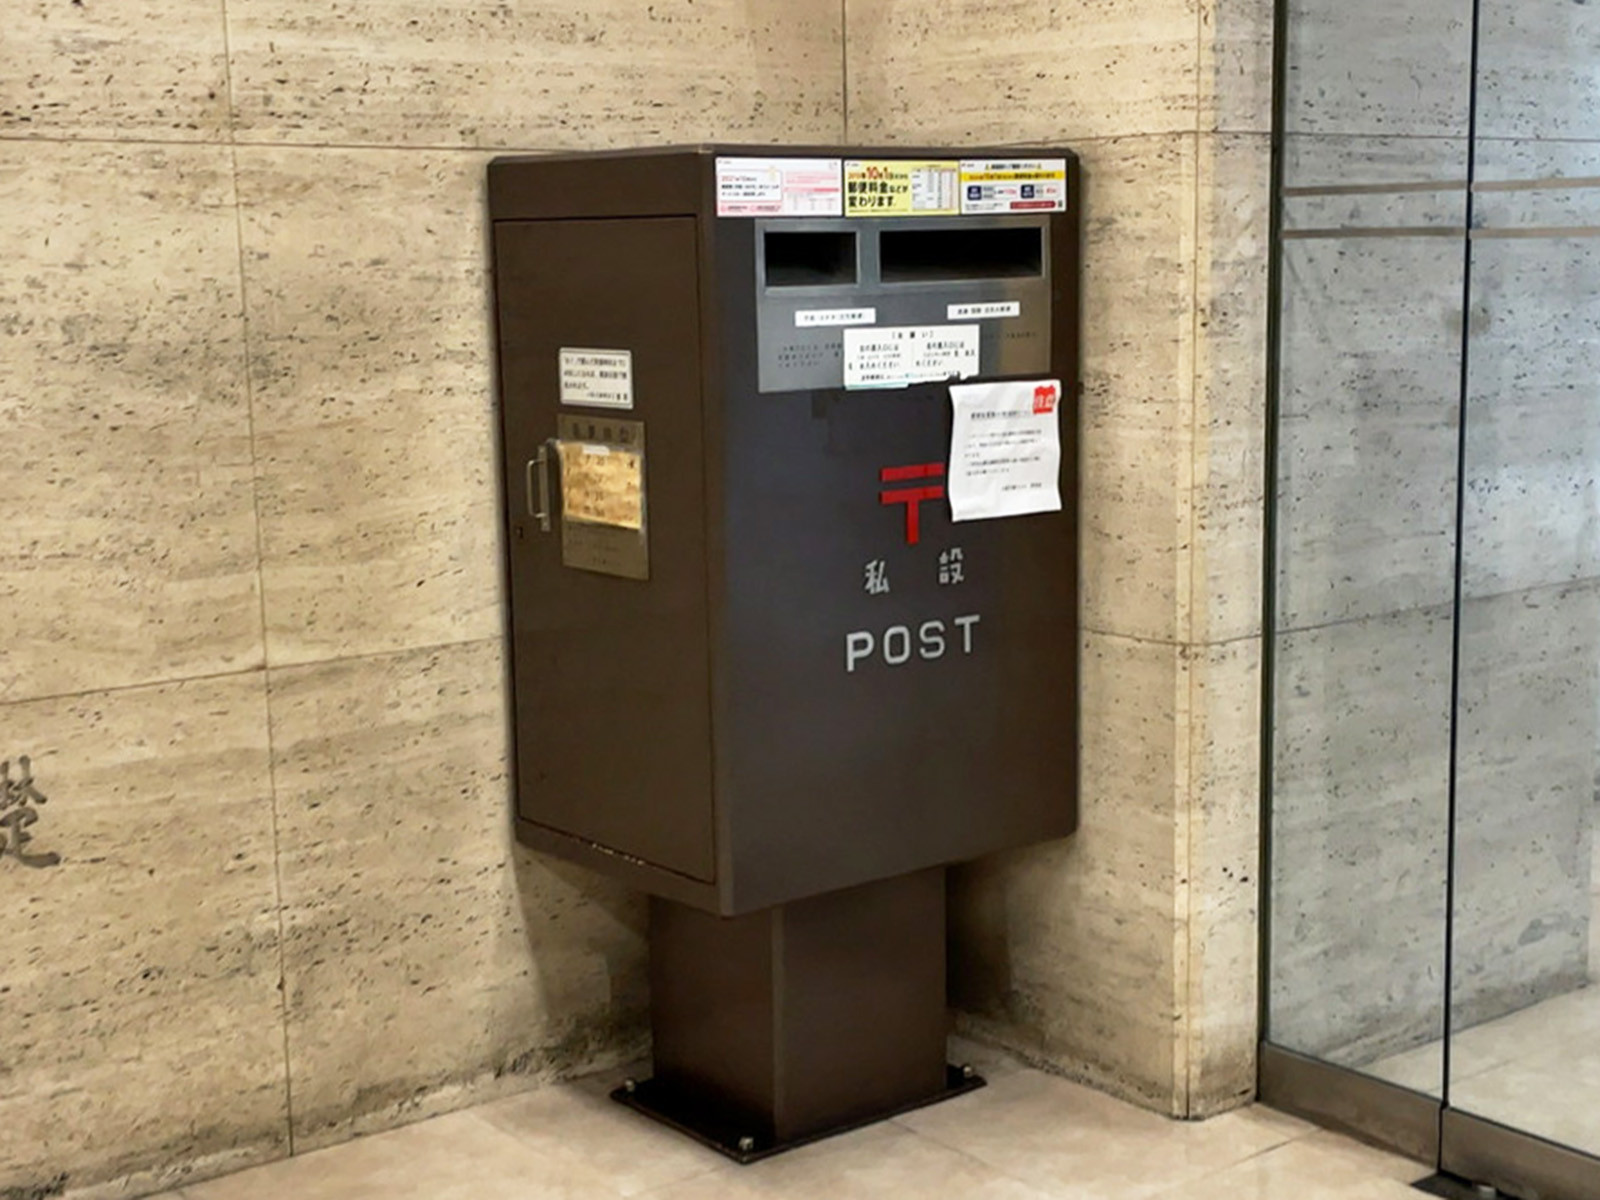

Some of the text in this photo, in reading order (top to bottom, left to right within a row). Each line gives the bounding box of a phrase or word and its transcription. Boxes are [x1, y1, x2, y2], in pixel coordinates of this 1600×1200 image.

[848, 181, 908, 194] 郵便料金などが
[864, 547, 964, 595] 私 設
[846, 614, 980, 672] POST
